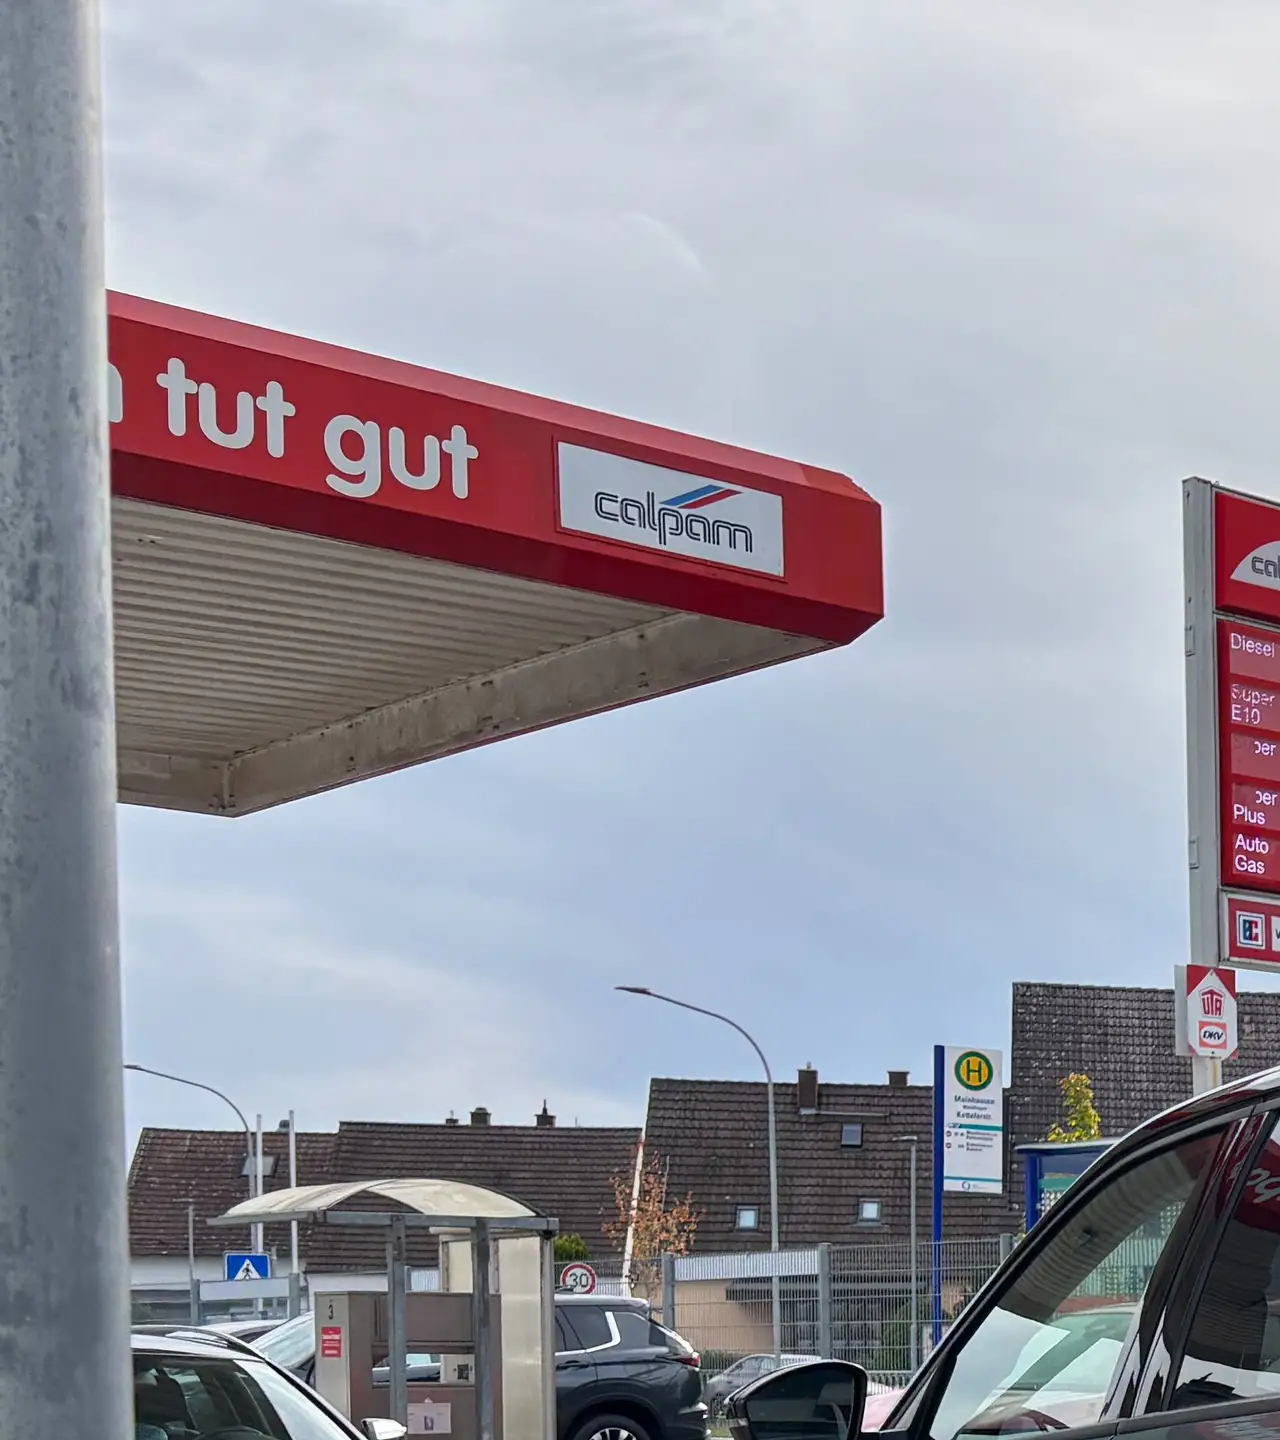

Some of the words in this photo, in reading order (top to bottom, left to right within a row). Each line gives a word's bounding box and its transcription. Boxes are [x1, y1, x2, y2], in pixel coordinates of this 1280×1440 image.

[156, 357, 296, 458] tut
[323, 413, 480, 499] gut
[594, 489, 753, 554] calpam
[1231, 632, 1275, 658] Diesel
[1231, 683, 1276, 707] Super
[1231, 703, 1261, 725] E10
[1233, 803, 1266, 826] Plus
[1235, 834, 1270, 854] Auto
[1235, 855, 1266, 874] Gas
[1201, 988, 1224, 1017] UTA
[1203, 1030, 1223, 1041] DKV
[966, 1059, 982, 1083] H
[569, 1272, 590, 1288] 30
[327, 1304, 334, 1320] 3
